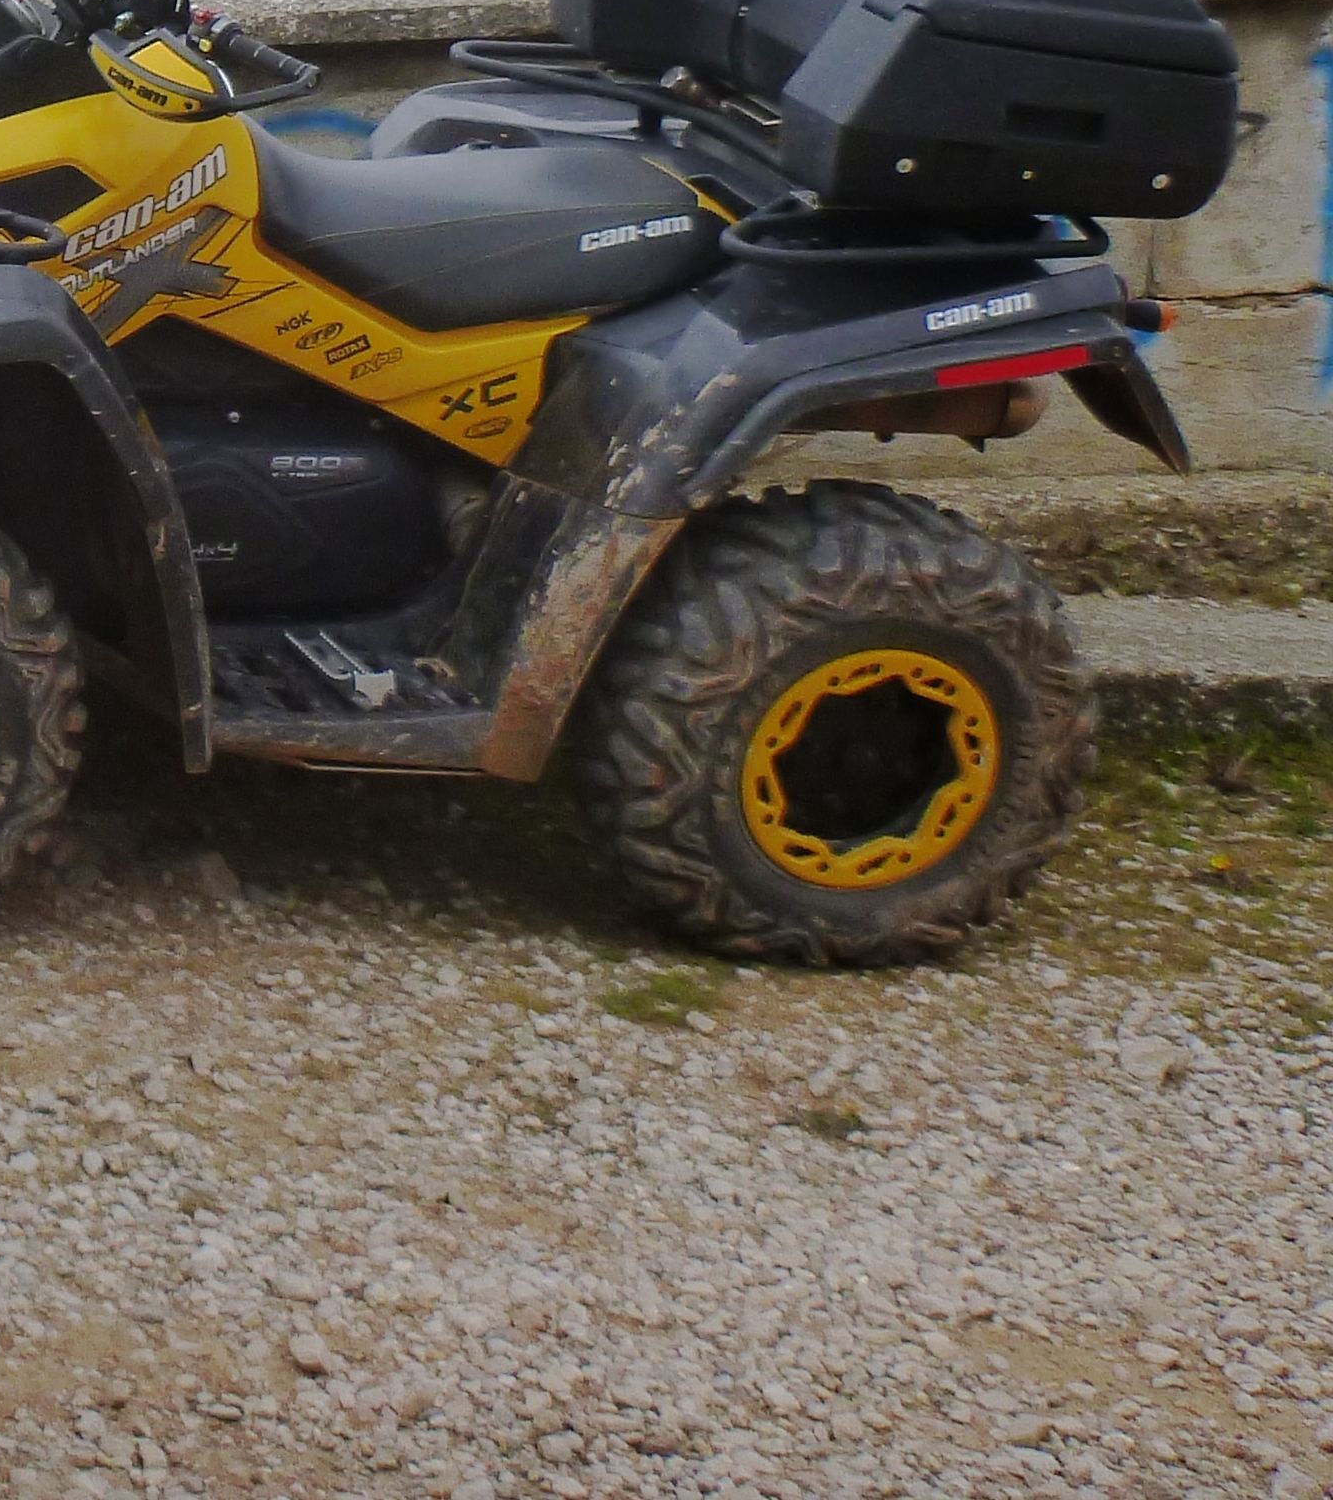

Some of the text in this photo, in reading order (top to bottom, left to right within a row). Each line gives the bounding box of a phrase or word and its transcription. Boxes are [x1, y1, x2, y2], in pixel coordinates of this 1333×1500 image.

[108, 66, 168, 107] can-am
[62, 144, 228, 263] can-am
[579, 214, 694, 253] can-am
[275, 310, 313, 336] NGK
[925, 292, 1032, 332] can-am
[439, 373, 521, 421] XC
